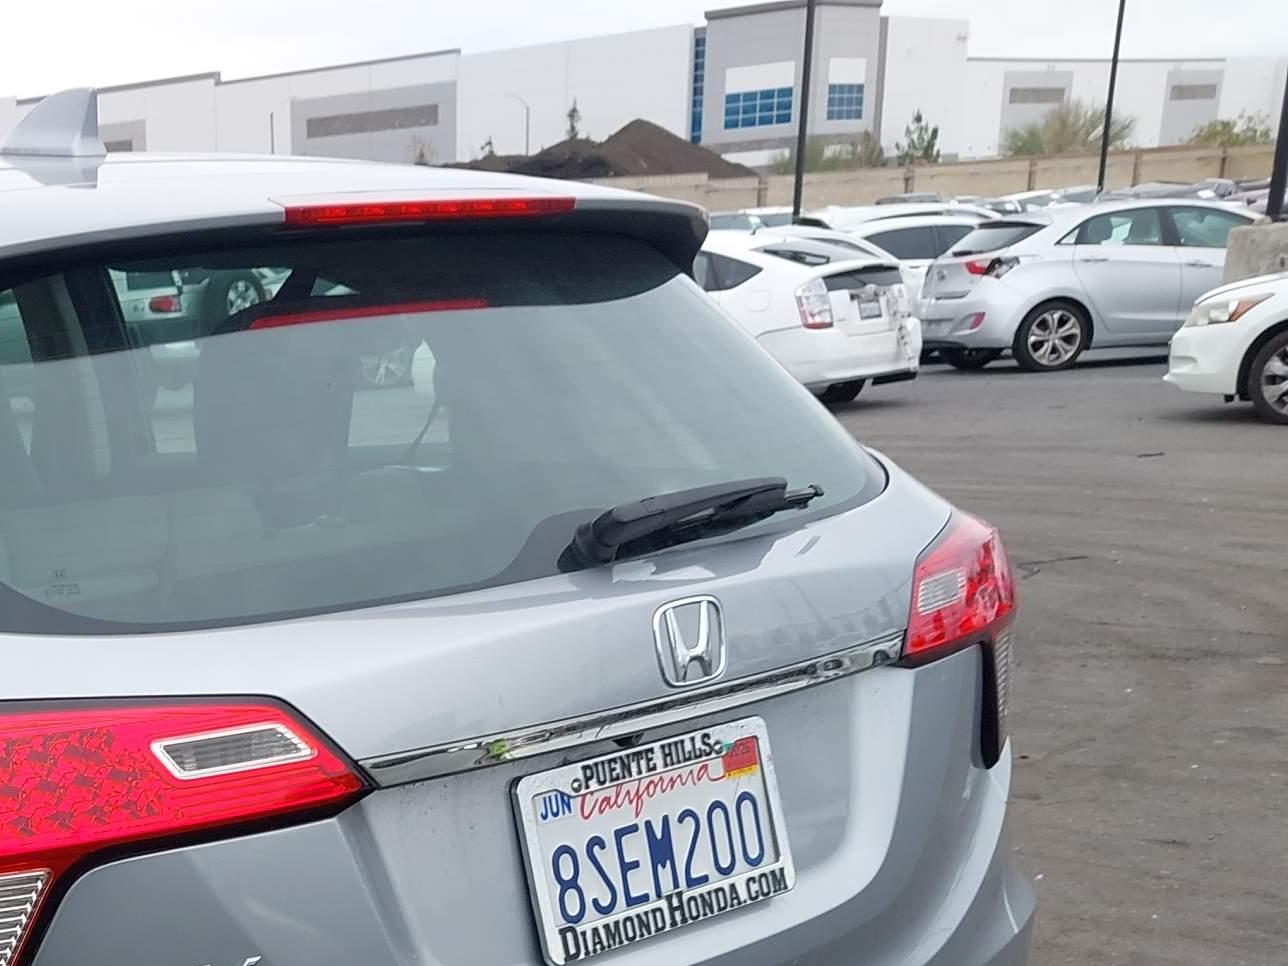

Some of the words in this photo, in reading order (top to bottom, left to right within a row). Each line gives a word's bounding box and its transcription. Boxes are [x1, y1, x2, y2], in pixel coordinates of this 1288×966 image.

[580, 749, 657, 791] PUENTE
[663, 732, 713, 767] HILLS
[540, 793, 573, 821] JUN
[580, 763, 726, 820] California
[551, 790, 765, 925] 8SEM200
